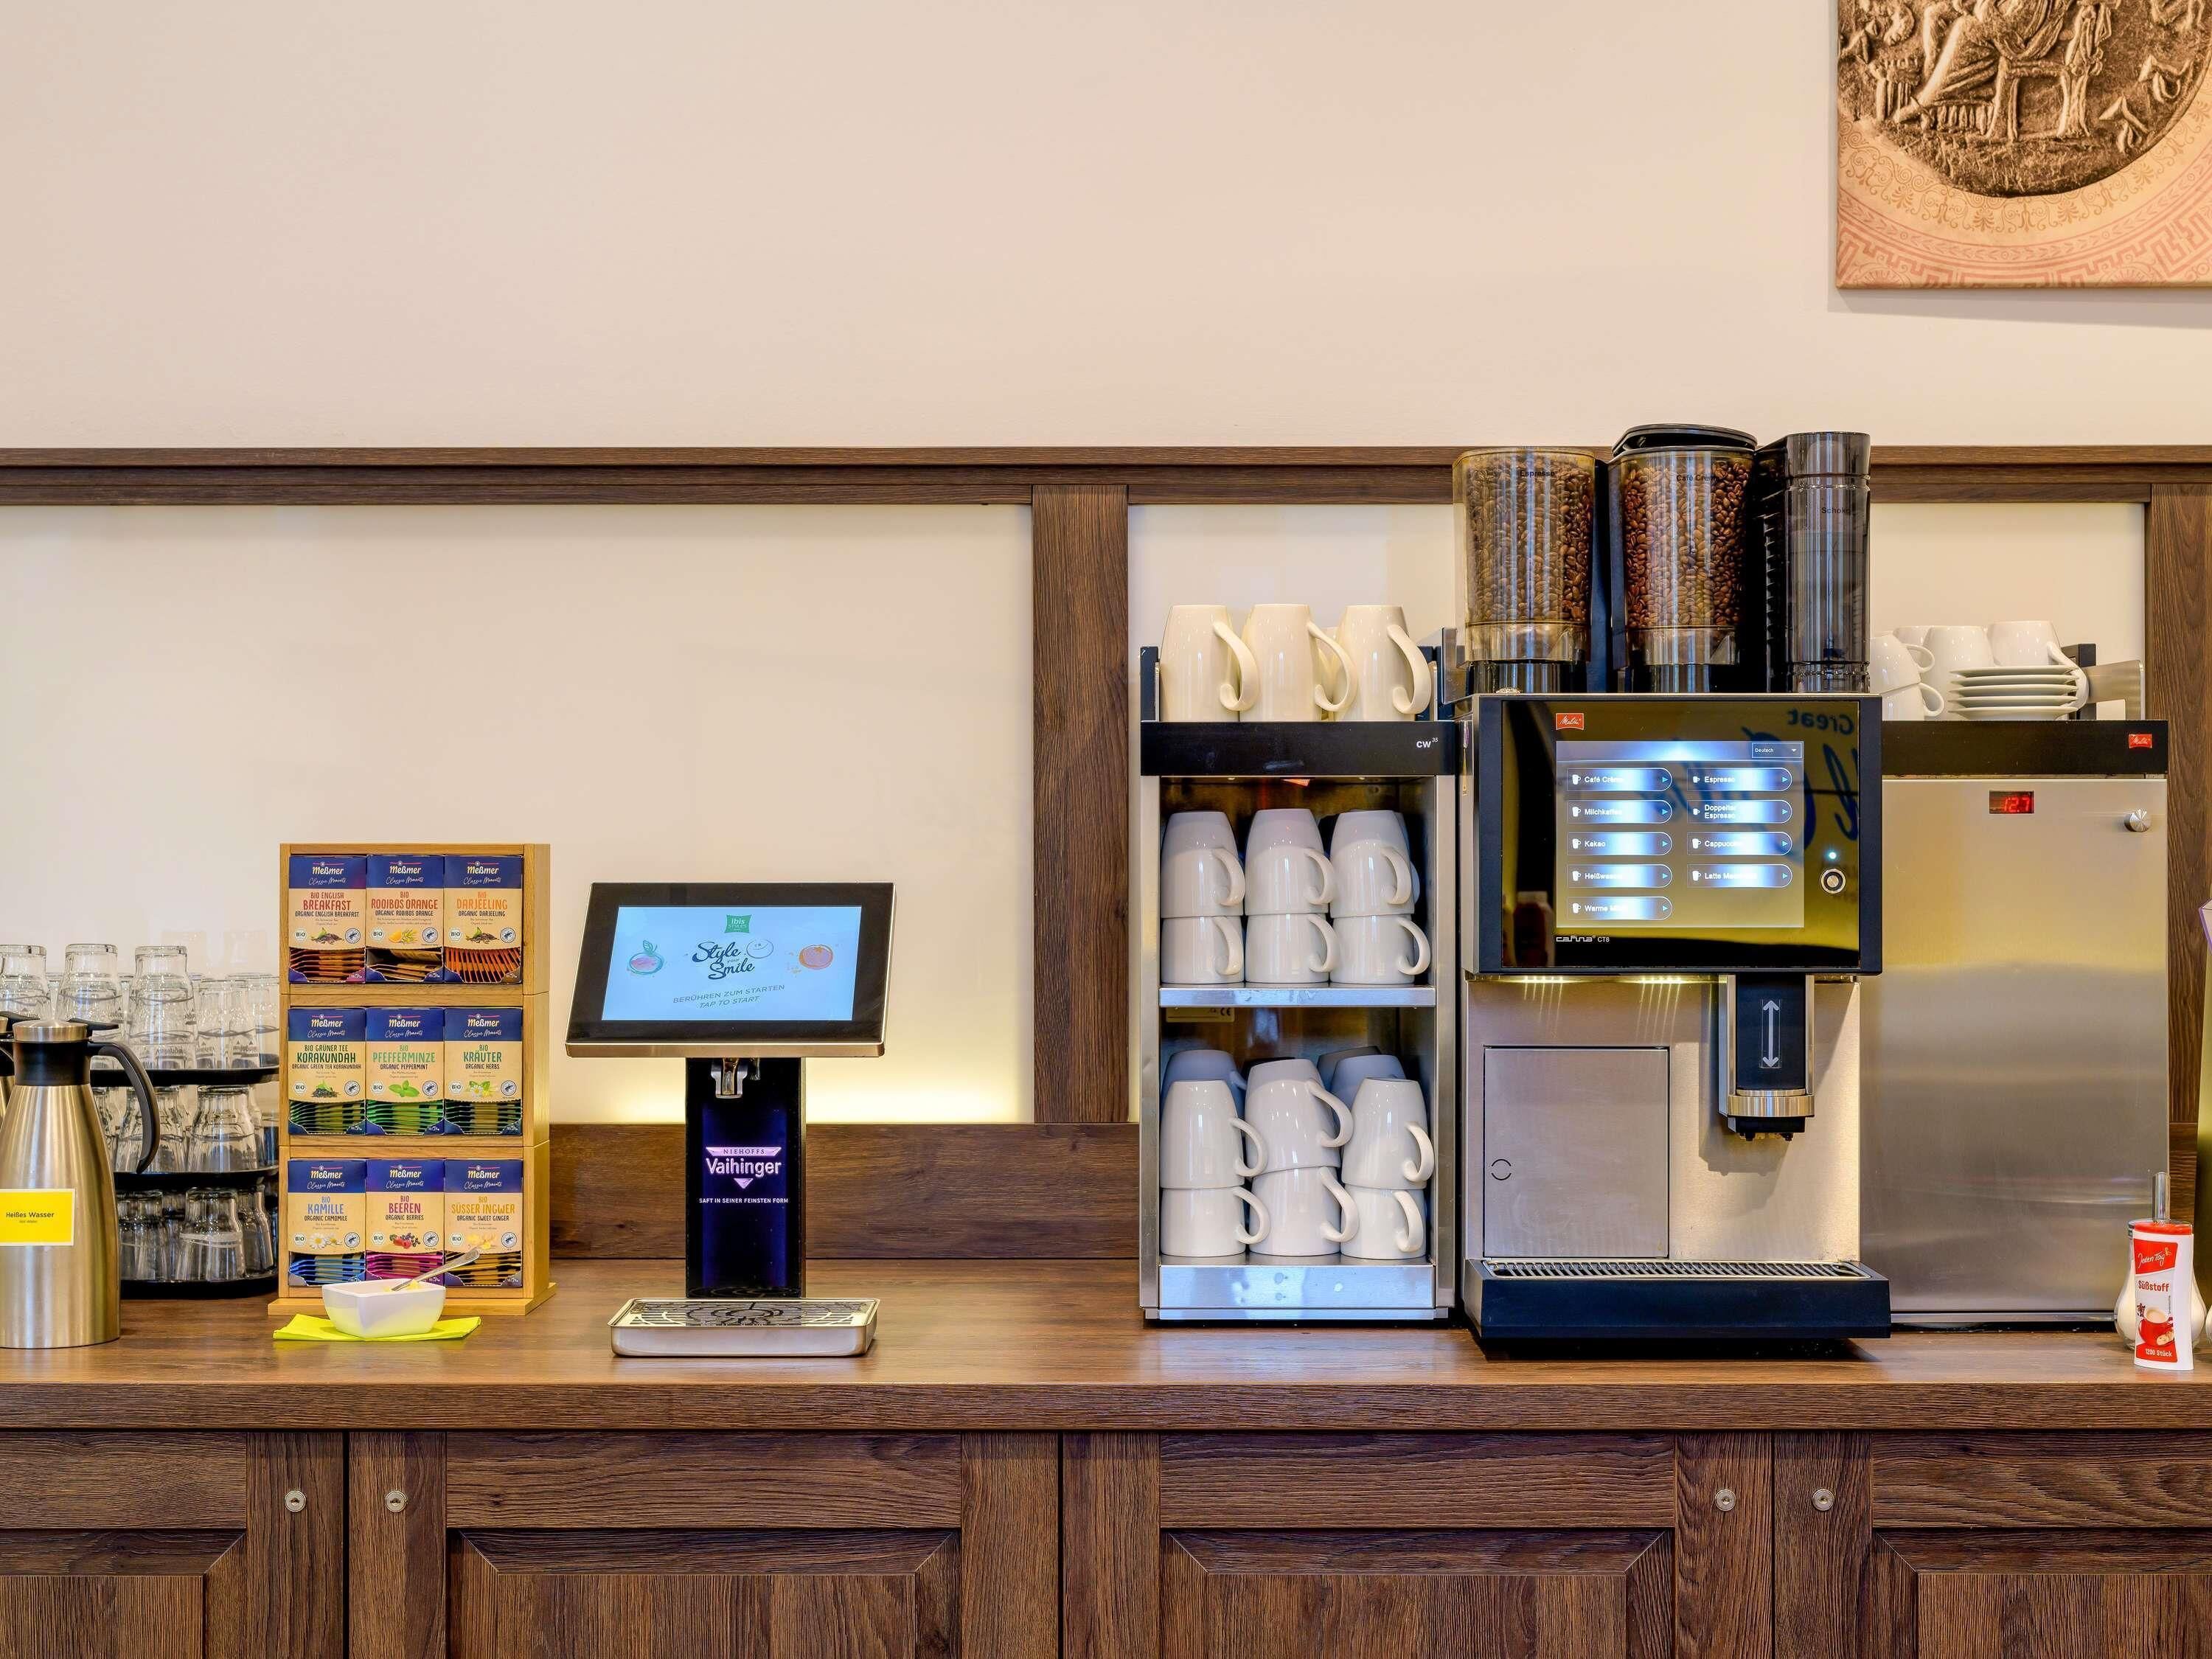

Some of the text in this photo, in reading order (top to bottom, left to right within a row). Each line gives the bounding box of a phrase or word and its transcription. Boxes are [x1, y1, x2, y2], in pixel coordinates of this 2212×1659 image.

[1520, 470, 1555, 478] Espresso
[1585, 775, 1600, 783] Café
[1704, 776, 1736, 784] Espresso
[312, 866, 344, 875] Meßmer
[389, 866, 422, 874] Meßmer
[467, 866, 499, 874] Meßmer
[303, 900, 351, 911] BREAKFAST
[371, 898, 438, 910] ROOIBOS ORANGE
[456, 899, 507, 910] DARJEELING
[692, 941, 742, 964] Style
[707, 958, 755, 980] Smile
[745, 984, 785, 995] STARTEN
[732, 995, 759, 1004] START
[311, 1019, 344, 1027] Meßmer
[389, 1019, 421, 1027] Meßmer
[467, 1018, 500, 1027] Meßmer
[297, 1052, 356, 1063] KORAKUNDAH
[372, 1052, 436, 1062] PFEFFERMINZE
[463, 1050, 502, 1062] KRÄUTER
[706, 1158, 782, 1178] Vaihinger
[310, 1170, 343, 1179] Meßmer
[389, 1169, 422, 1178] Meßmer
[467, 1170, 500, 1179] Meßmer
[307, 1203, 344, 1214] KAMILLE
[389, 1203, 421, 1214] BEEREN
[482, 1203, 515, 1214] INGWER
[2154, 1251, 2166, 1267] Tag
[2138, 1280, 2170, 1292] Süßstoff
[2156, 1349, 2172, 1357] Stück
